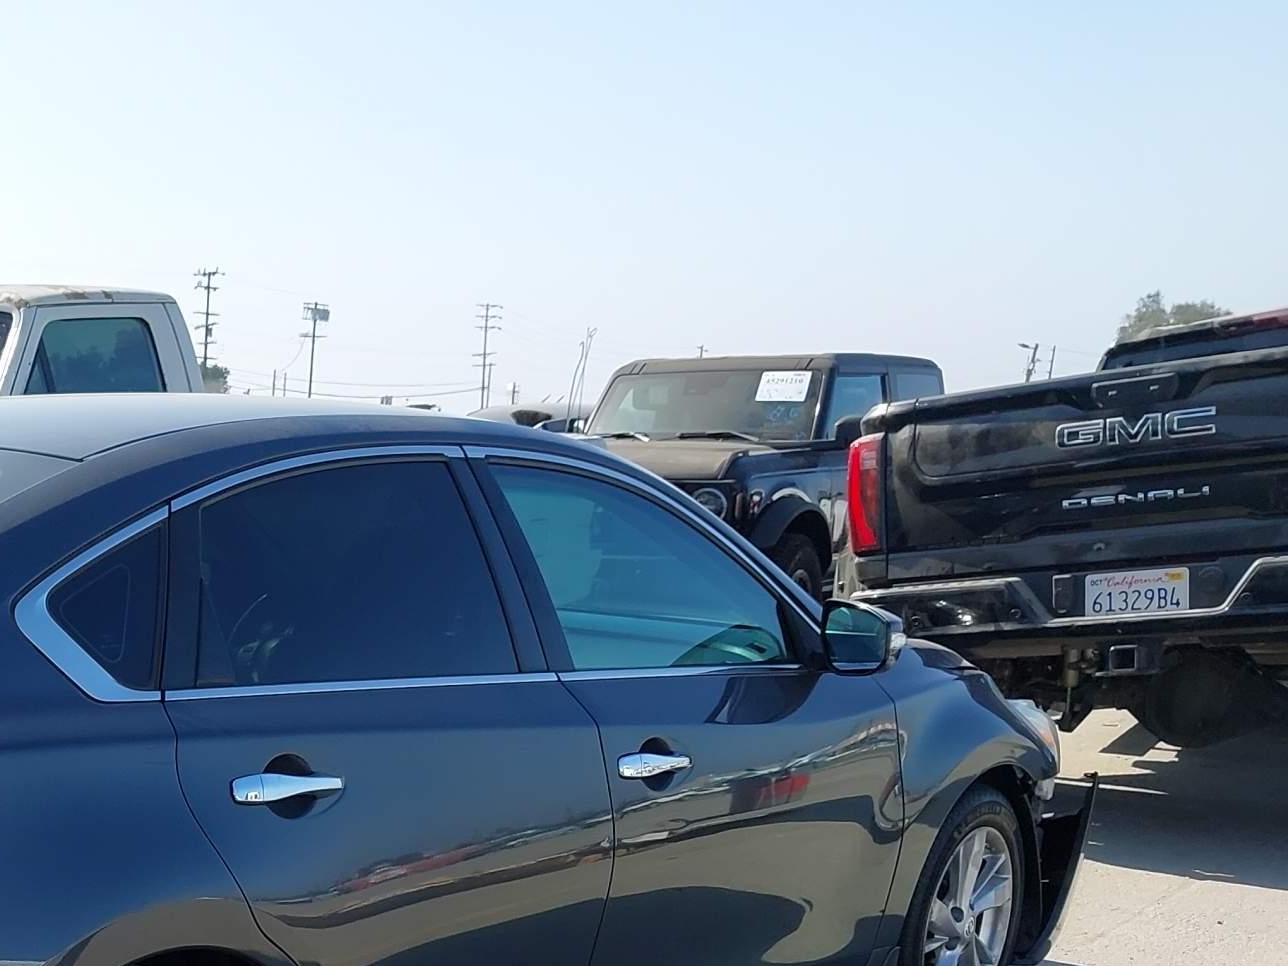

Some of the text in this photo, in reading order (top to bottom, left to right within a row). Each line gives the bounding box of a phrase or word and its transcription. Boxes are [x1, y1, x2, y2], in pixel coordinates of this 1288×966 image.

[1056, 406, 1216, 448] GMC
[1062, 486, 1210, 510] DENALI
[1090, 579, 1103, 587] OCT
[1106, 575, 1163, 589] California
[1092, 587, 1181, 613] 61329B4
